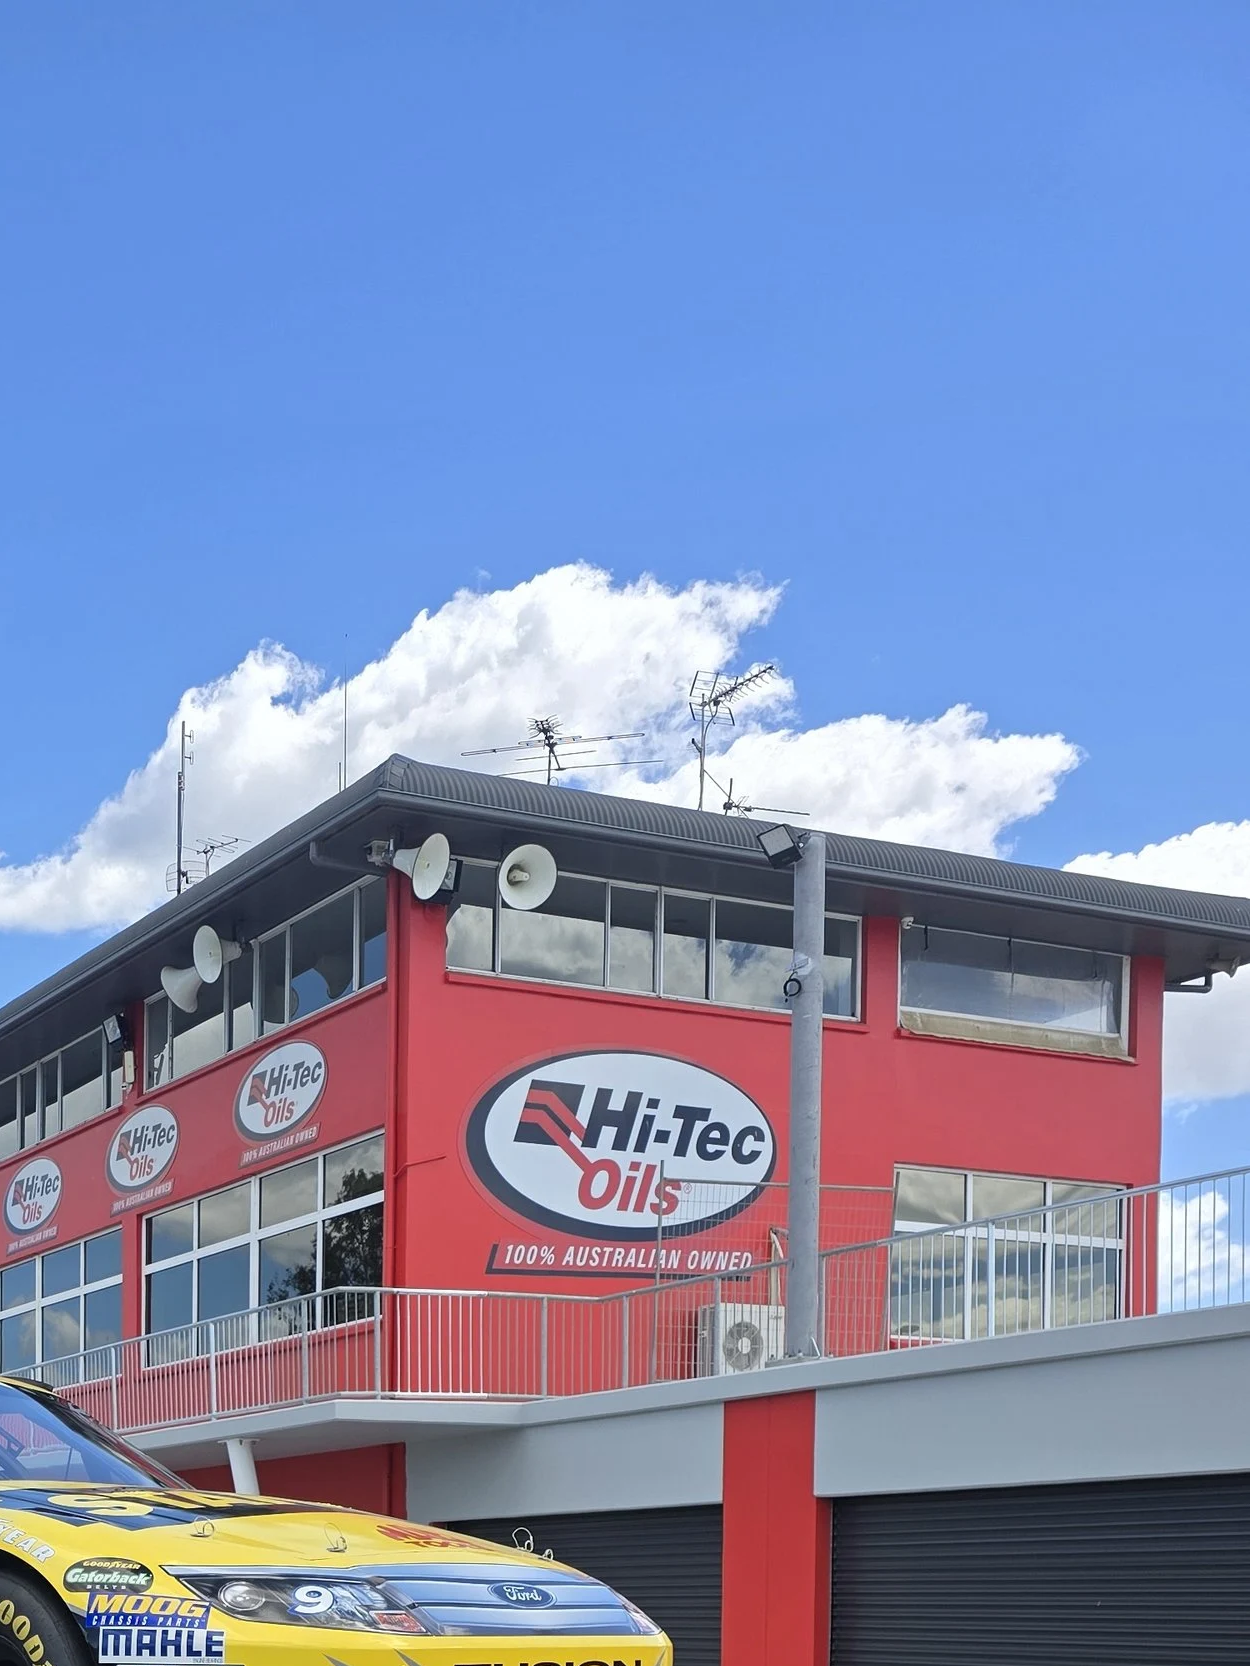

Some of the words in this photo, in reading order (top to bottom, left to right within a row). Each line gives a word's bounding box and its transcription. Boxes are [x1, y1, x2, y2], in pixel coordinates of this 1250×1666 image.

[265, 1060, 322, 1100] Hi-Tec
[263, 1097, 296, 1128] Oils
[581, 1087, 765, 1165] Hi-Tec
[129, 1122, 176, 1156] Hi-Tec
[242, 1146, 258, 1162] 100%
[258, 1134, 296, 1158] AUSTRALIAN
[295, 1126, 318, 1143] OWNED
[130, 1154, 154, 1181] Oils
[23, 1173, 60, 1202] Hi-Tec
[578, 1157, 682, 1216] Oils
[22, 1202, 43, 1225] Oils
[505, 1244, 555, 1266] 100%
[562, 1245, 679, 1270] AUSTRALIAN
[687, 1250, 752, 1271] OWNED
[65, 1568, 152, 1587] Gatorback
[82, 1560, 141, 1570] GOODYEAR
[89, 1594, 210, 1618] MOOG
[291, 1584, 335, 1615] 9
[502, 1585, 543, 1602] Ford
[92, 1616, 148, 1627] CHASSIS
[158, 1617, 200, 1628] PARTS
[101, 1629, 224, 1658] MAHLE
